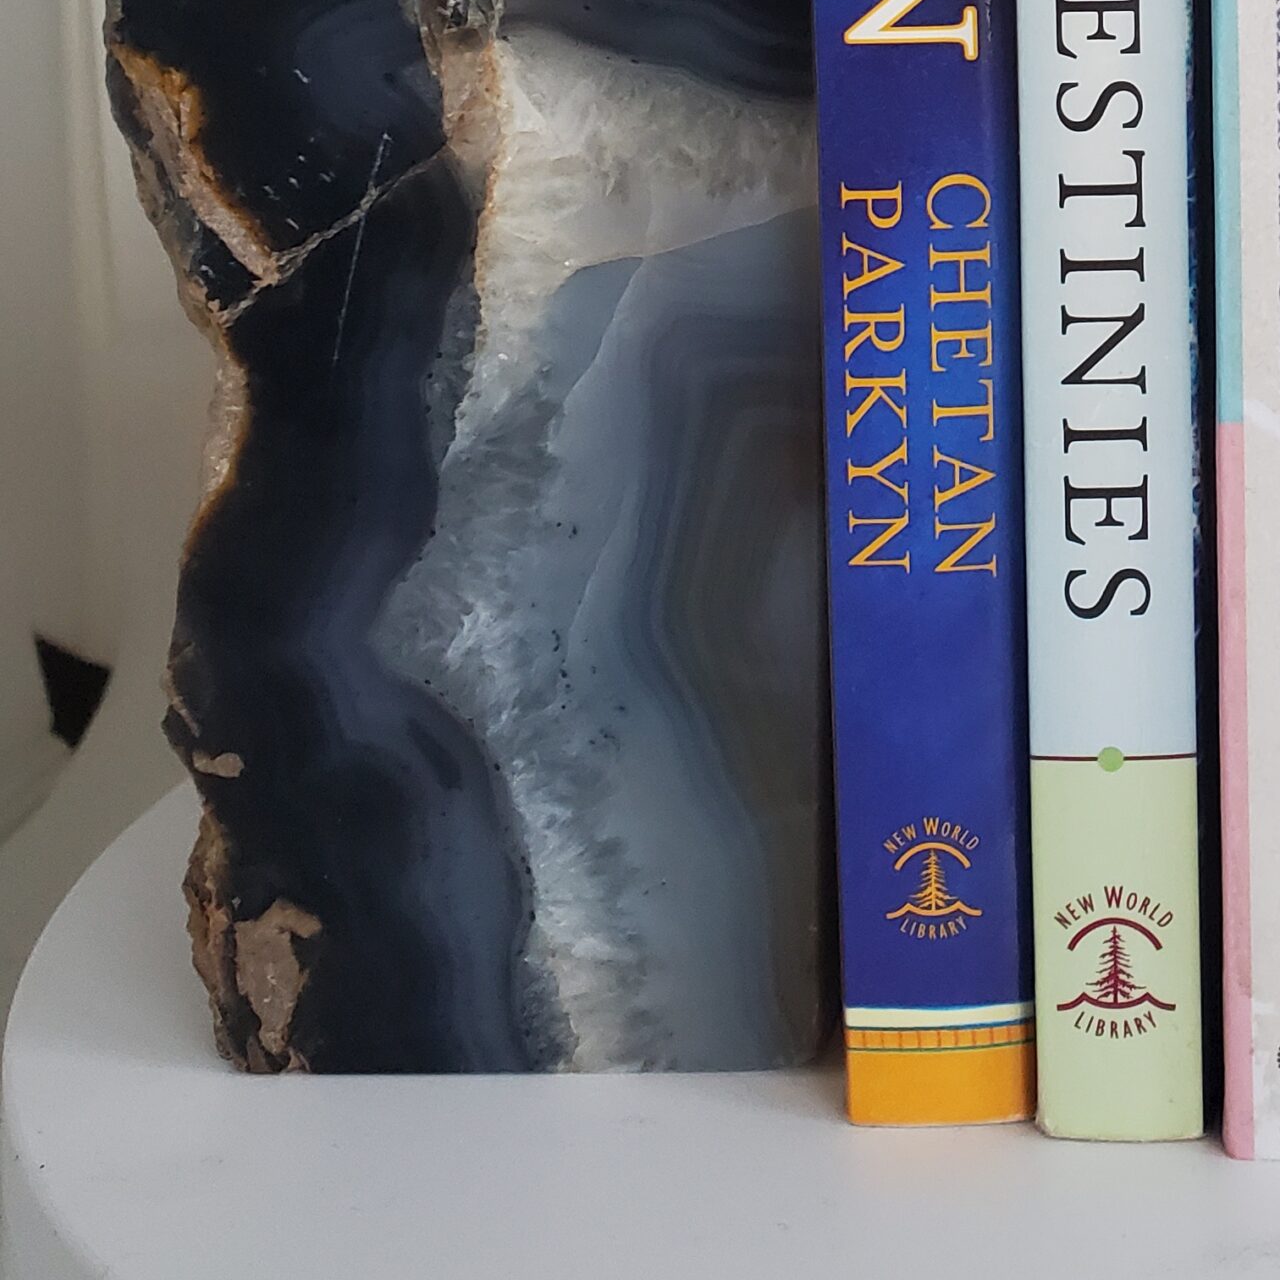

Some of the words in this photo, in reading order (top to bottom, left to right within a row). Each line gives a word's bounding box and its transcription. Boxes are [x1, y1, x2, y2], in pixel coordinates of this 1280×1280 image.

[840, 181, 912, 574] PARKYN
[925, 173, 997, 577] CHETAN
[883, 823, 917, 854] NEW
[922, 816, 980, 852] WORLD
[899, 915, 968, 941] LIBRARY
[1053, 893, 1096, 931] NEW
[1103, 885, 1175, 929] WORLD
[1073, 1010, 1158, 1040] LIBRARY
